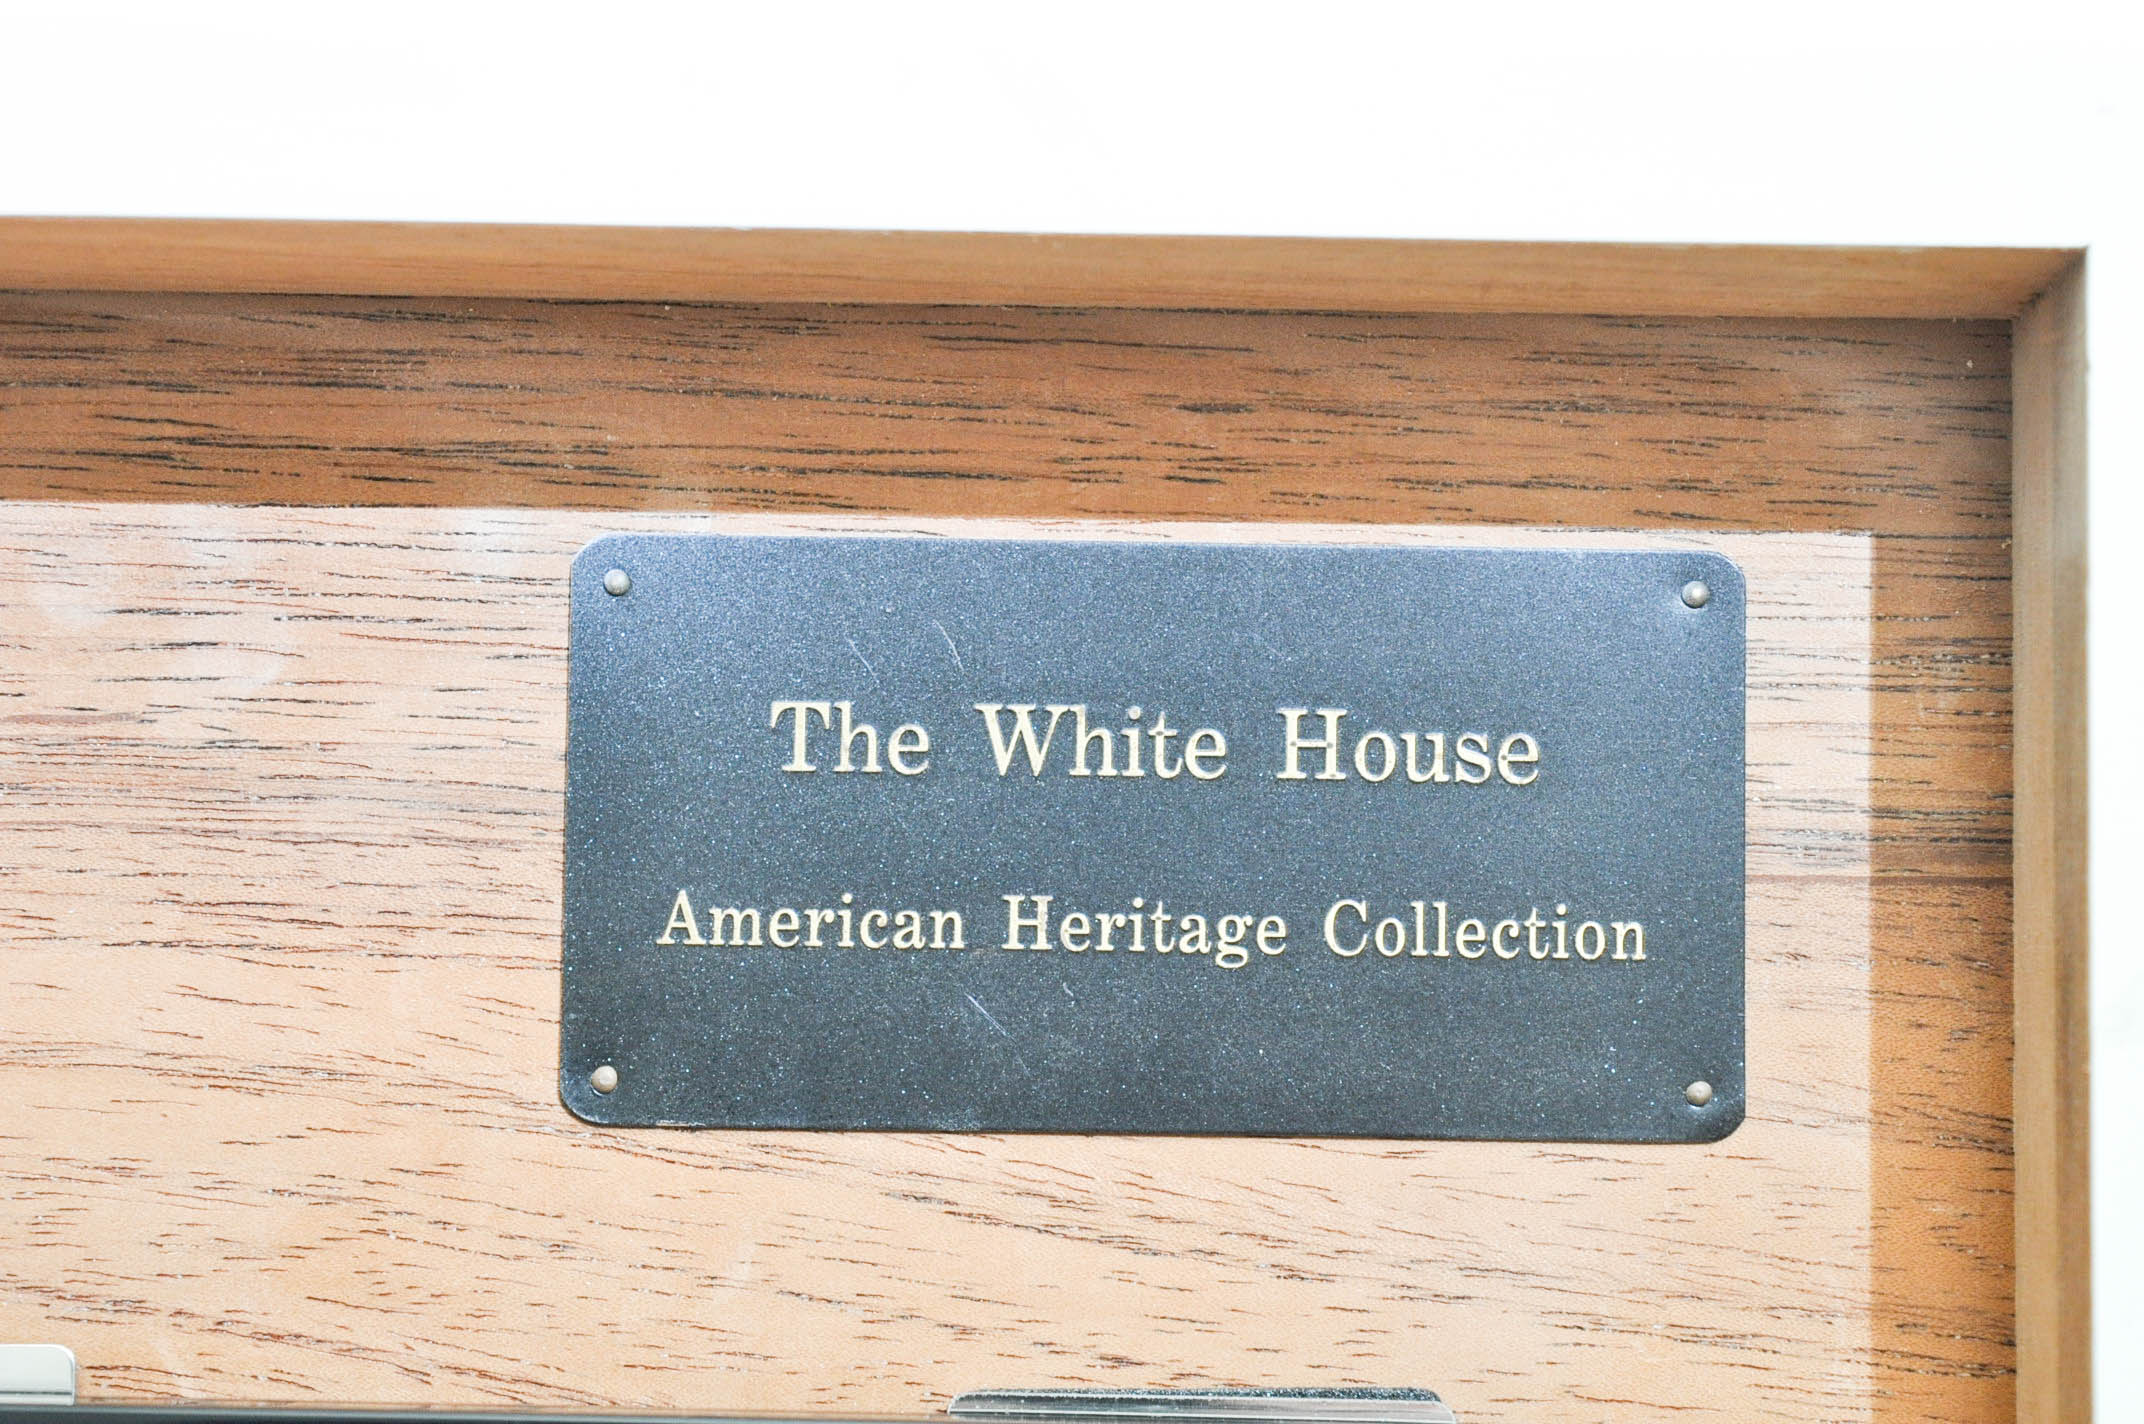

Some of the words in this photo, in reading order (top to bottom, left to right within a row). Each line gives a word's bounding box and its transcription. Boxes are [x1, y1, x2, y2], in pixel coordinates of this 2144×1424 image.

[770, 700, 931, 777] The
[975, 702, 1229, 782] White
[1276, 707, 1541, 787] House
[656, 889, 967, 951] American
[1002, 893, 1289, 971] Heritage
[1323, 898, 1648, 963] Collection
